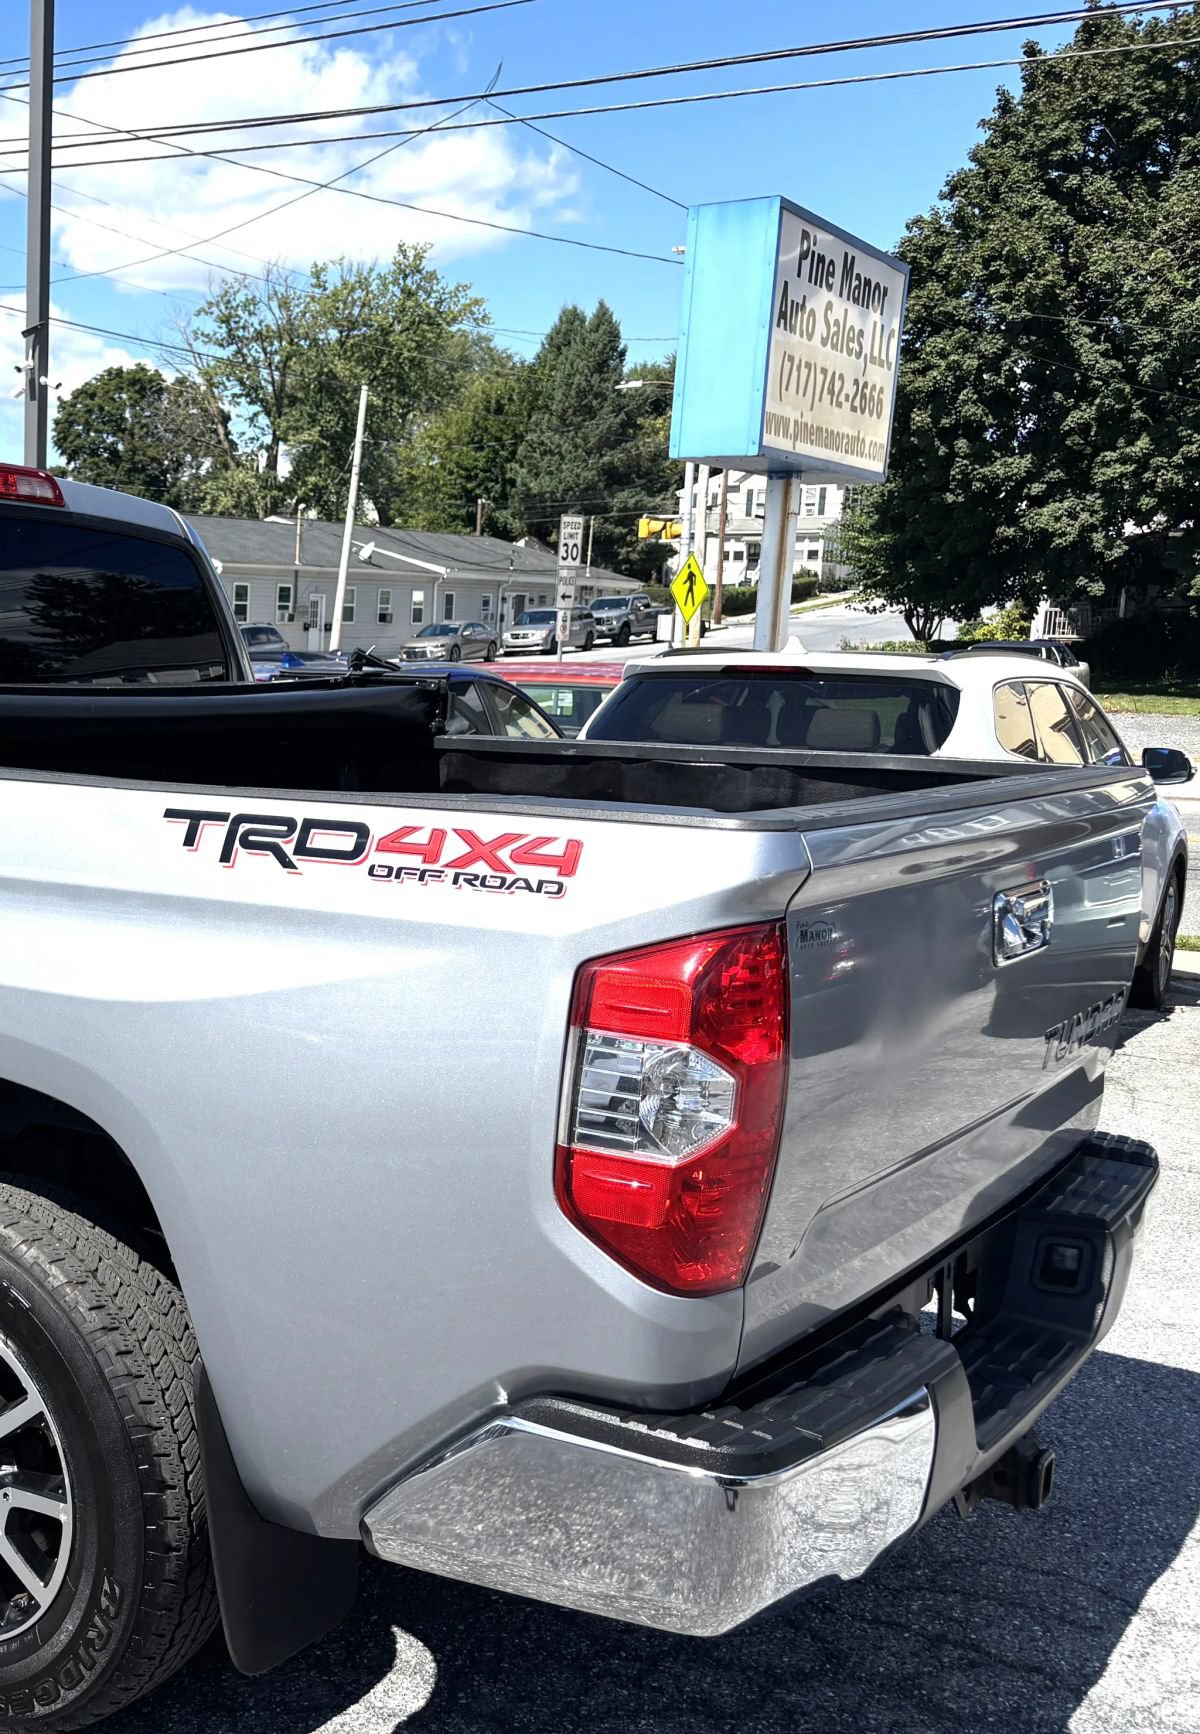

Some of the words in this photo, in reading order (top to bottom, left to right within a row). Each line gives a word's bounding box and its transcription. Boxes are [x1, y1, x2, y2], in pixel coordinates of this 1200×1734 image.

[796, 228, 836, 292] Pine
[839, 251, 889, 316] Manor
[776, 280, 817, 343] Auto
[765, 410, 885, 464] www.pinemanorauto.com
[562, 520, 581, 530] SPEED
[562, 532, 579, 541] LIMIT
[561, 543, 579, 561] 30
[559, 576, 576, 586] POLICE
[163, 808, 374, 874] TRD
[368, 864, 444, 884] OFF
[452, 871, 567, 898] ROAD
